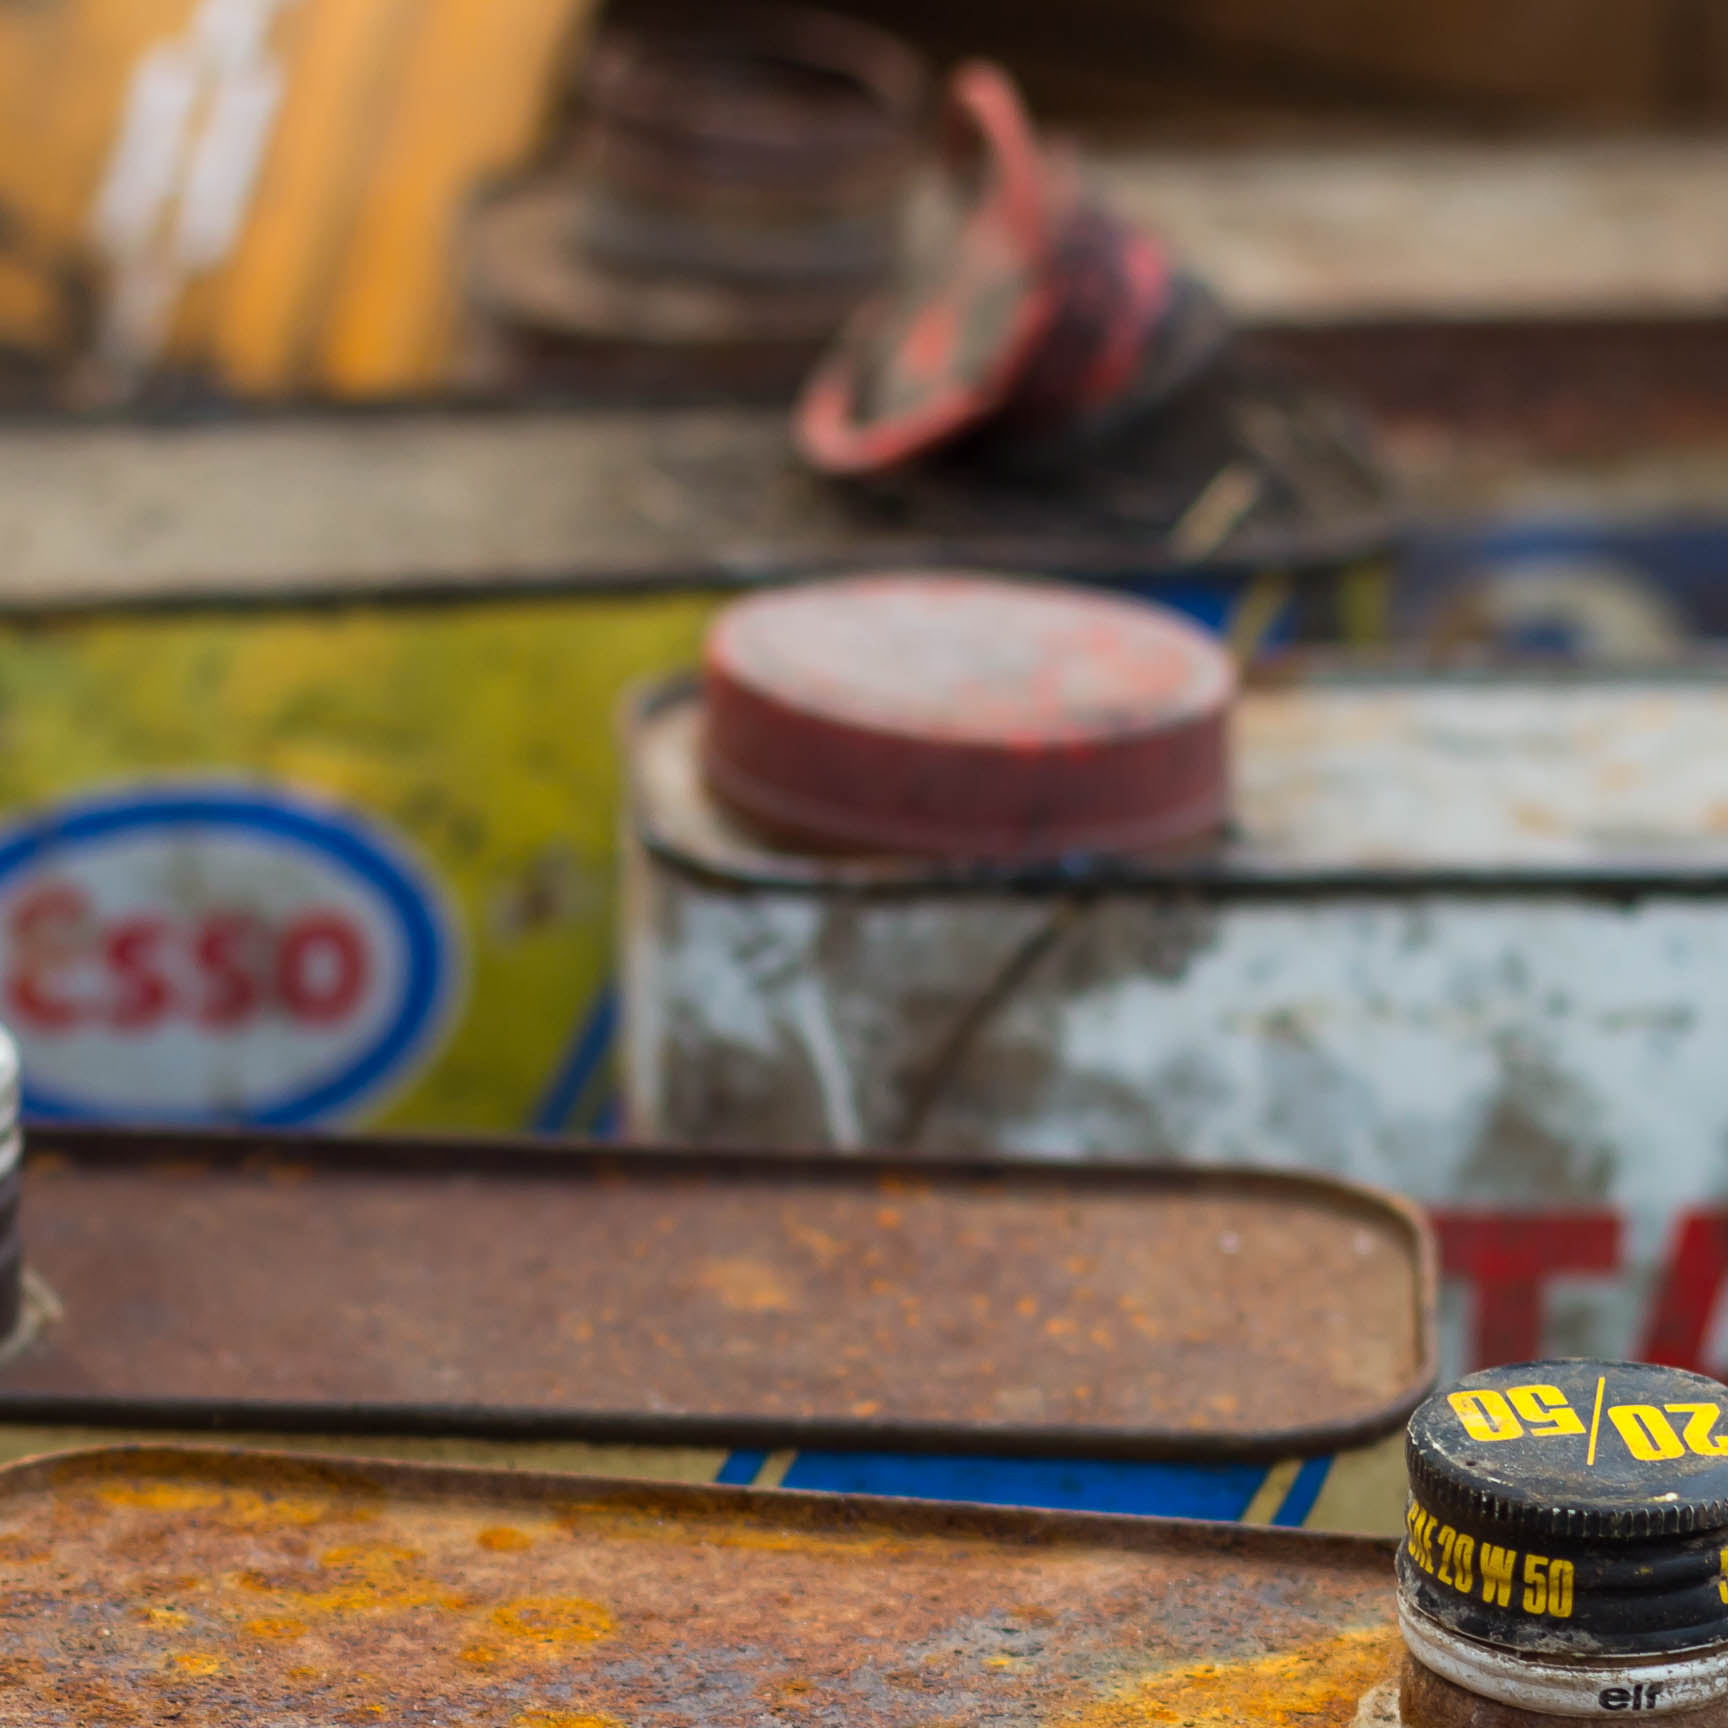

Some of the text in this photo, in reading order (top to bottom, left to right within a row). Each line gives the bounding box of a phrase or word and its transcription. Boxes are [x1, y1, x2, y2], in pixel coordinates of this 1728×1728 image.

[1438, 1524, 1475, 1594] 20
[1480, 1542, 1517, 1608] W
[1522, 1553, 1575, 1619] 50
[1598, 1681, 1665, 1711] elf
